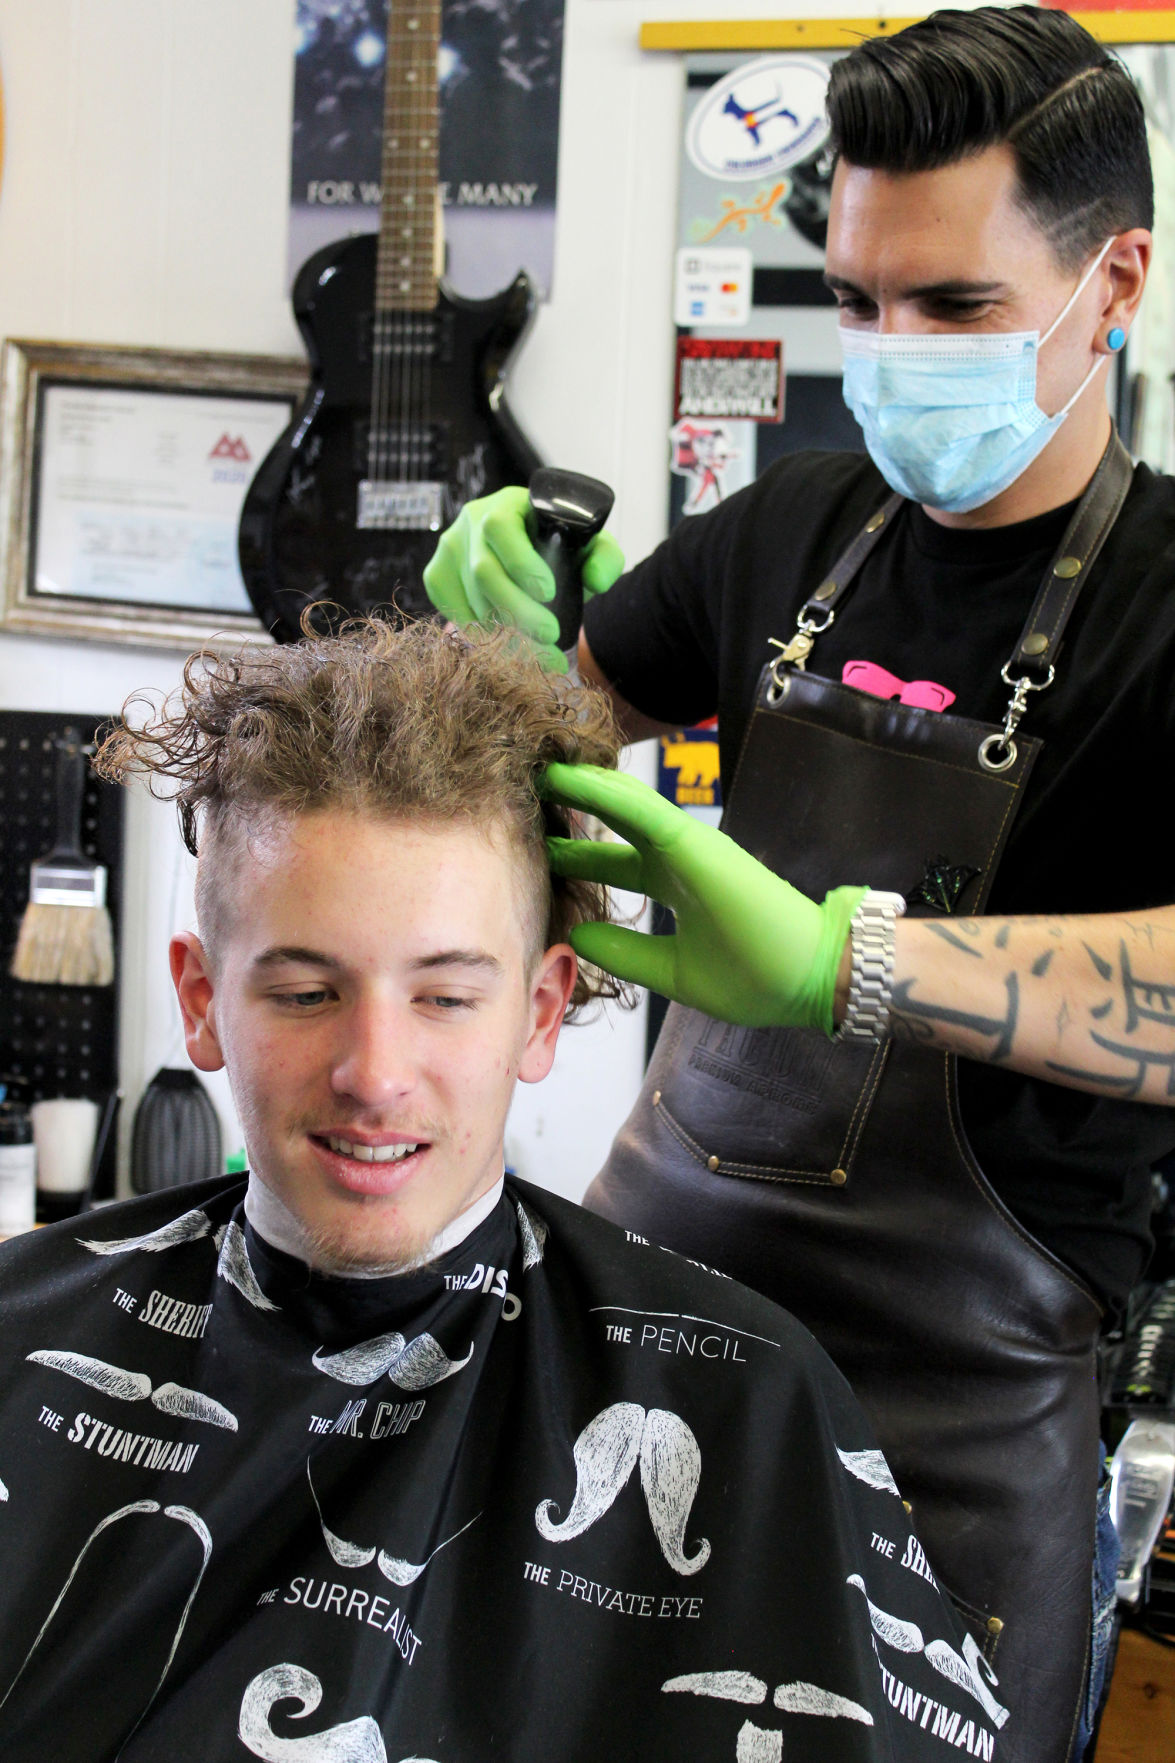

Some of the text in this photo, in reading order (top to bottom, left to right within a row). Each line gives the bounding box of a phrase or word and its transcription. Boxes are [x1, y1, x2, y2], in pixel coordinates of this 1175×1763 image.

[307, 180, 354, 205] FOR
[457, 182, 538, 206] MANY
[112, 1288, 137, 1314] THE
[606, 1325, 746, 1362] THE PENCIL
[308, 1415, 333, 1434] THE
[370, 1400, 426, 1439] CHIP
[37, 1405, 200, 1474] THE STUNTMAN
[871, 1532, 896, 1559] THE
[523, 1562, 703, 1619] THE PRIVATE EYE
[257, 1577, 422, 1666] THE SURREALIST
